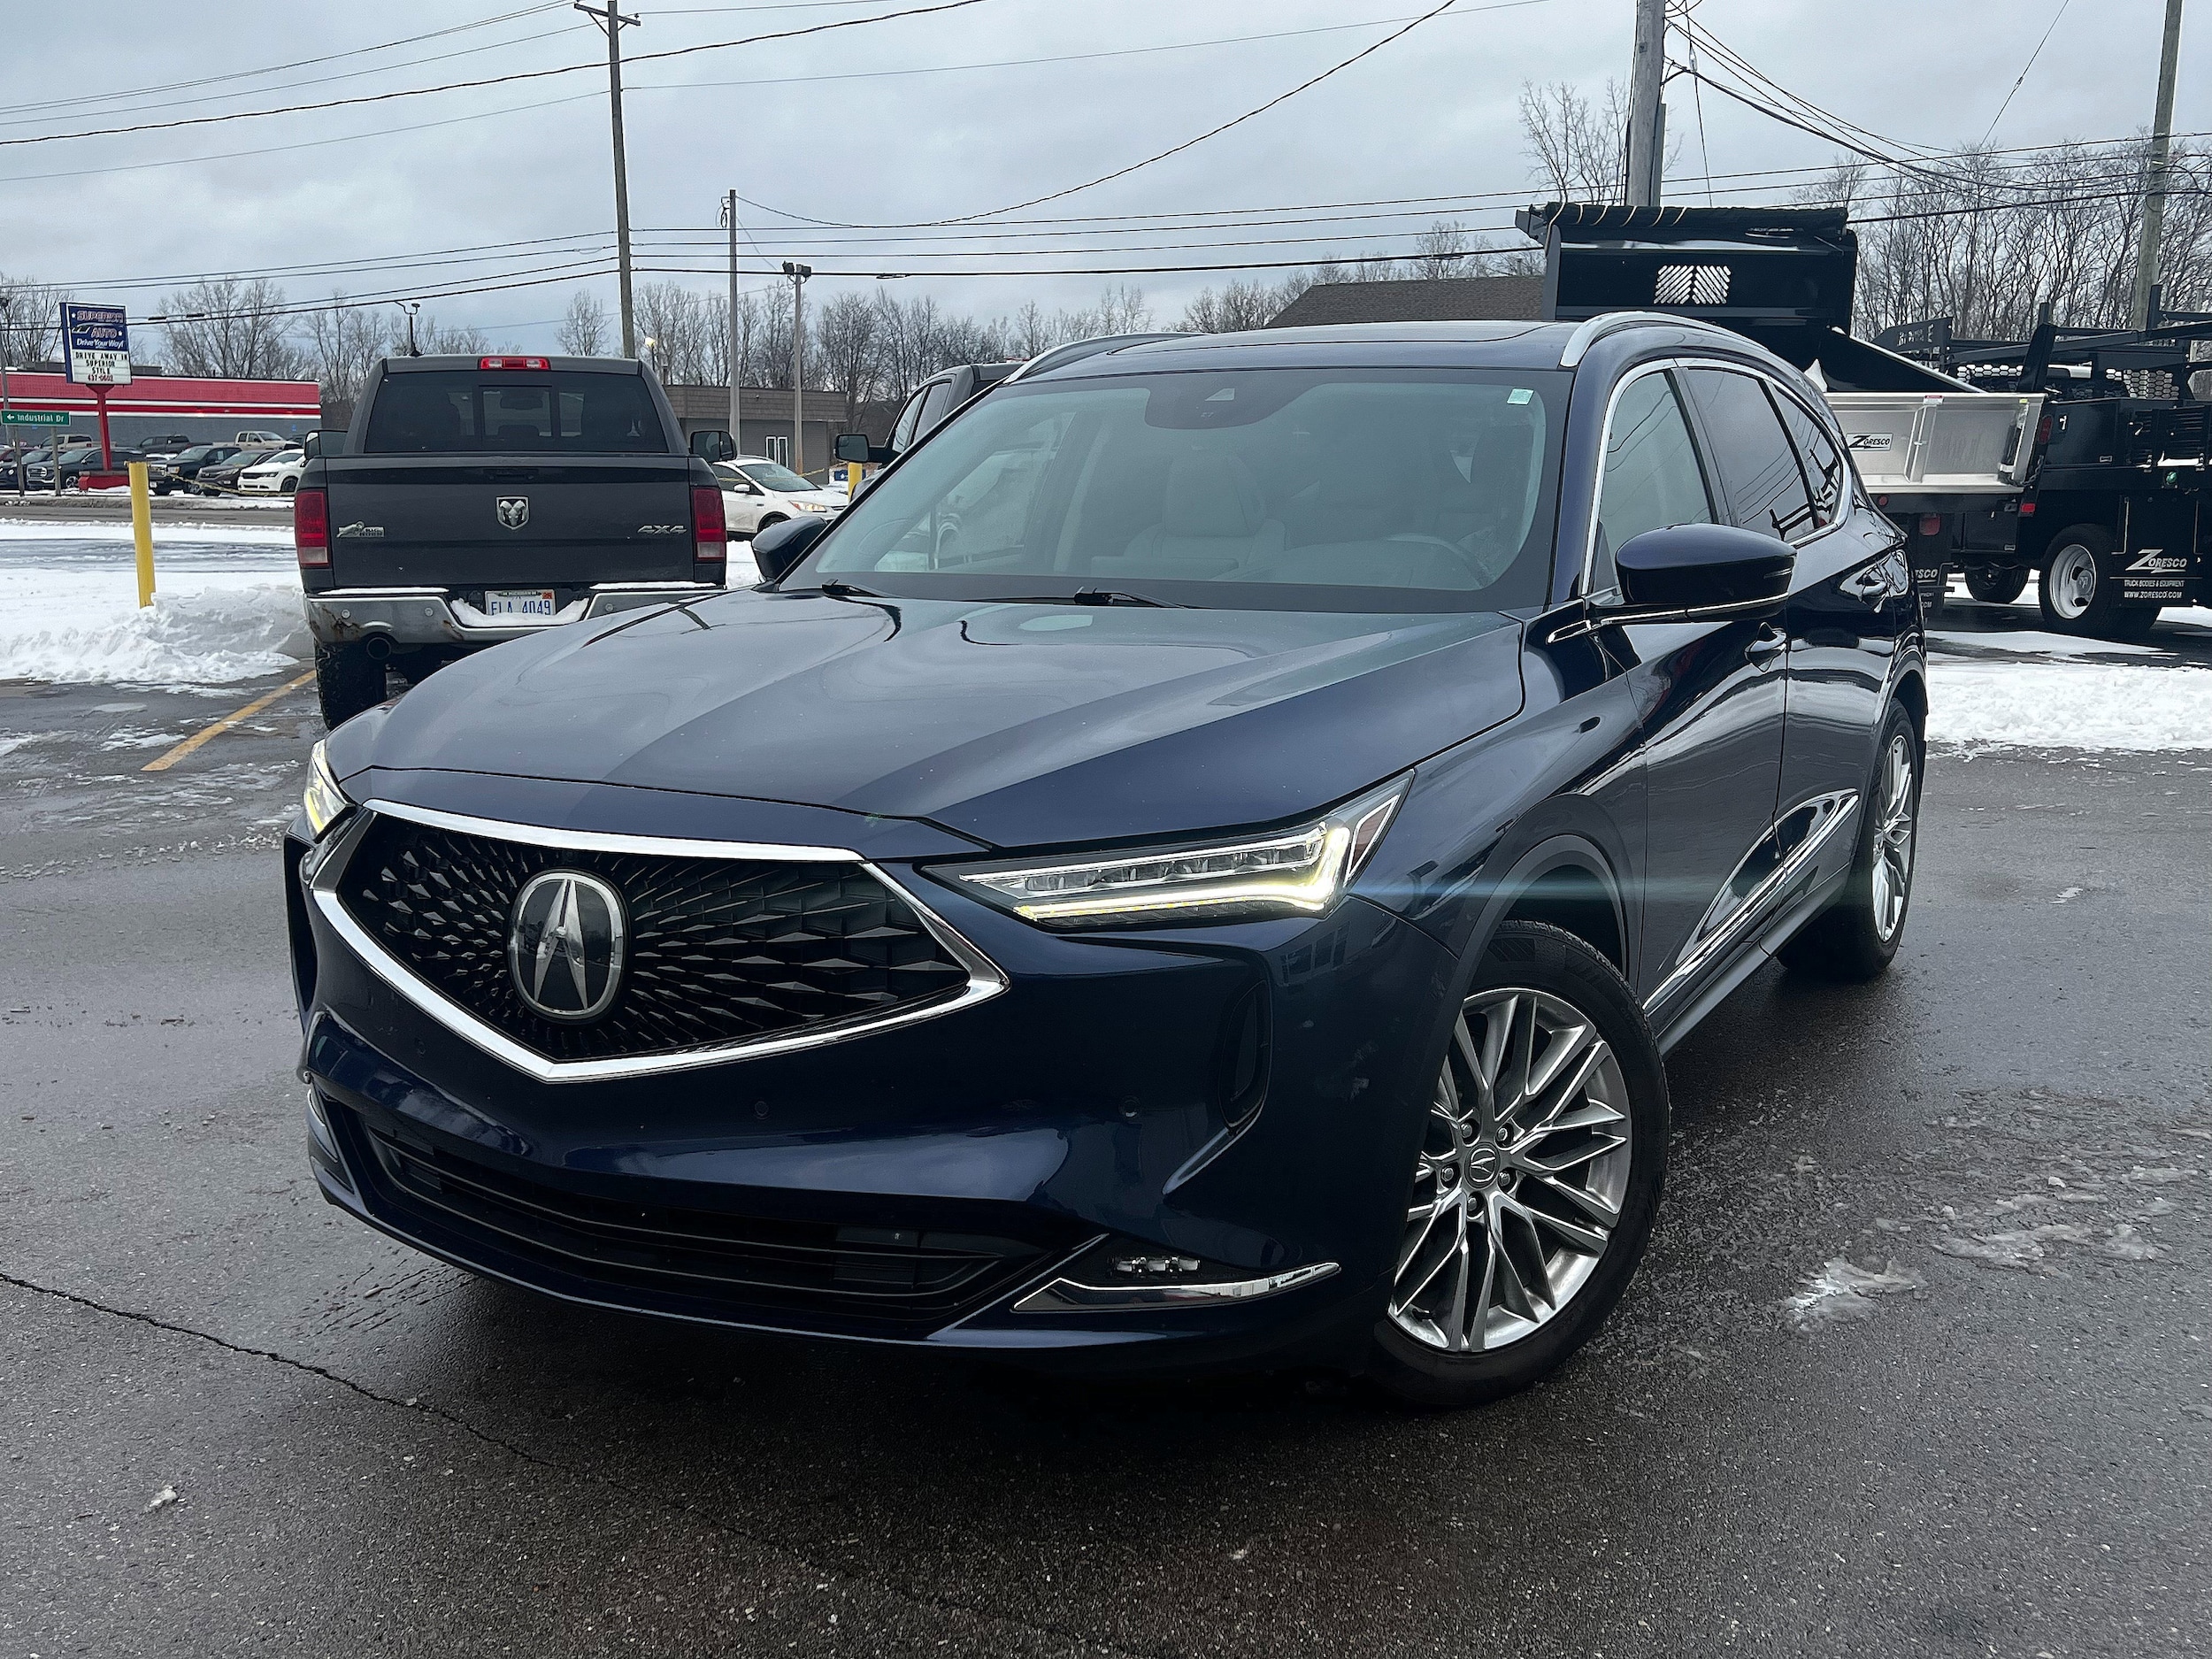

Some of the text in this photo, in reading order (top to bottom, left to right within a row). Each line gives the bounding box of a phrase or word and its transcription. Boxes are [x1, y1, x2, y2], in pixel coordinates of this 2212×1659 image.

[77, 310, 123, 323] SUPERIOR
[91, 326, 118, 338] AUTO
[77, 337, 94, 346] Drive
[17, 413, 54, 422] Industrial
[1849, 434, 1891, 449] ZORESCO
[2125, 549, 2187, 573] ZORESCO
